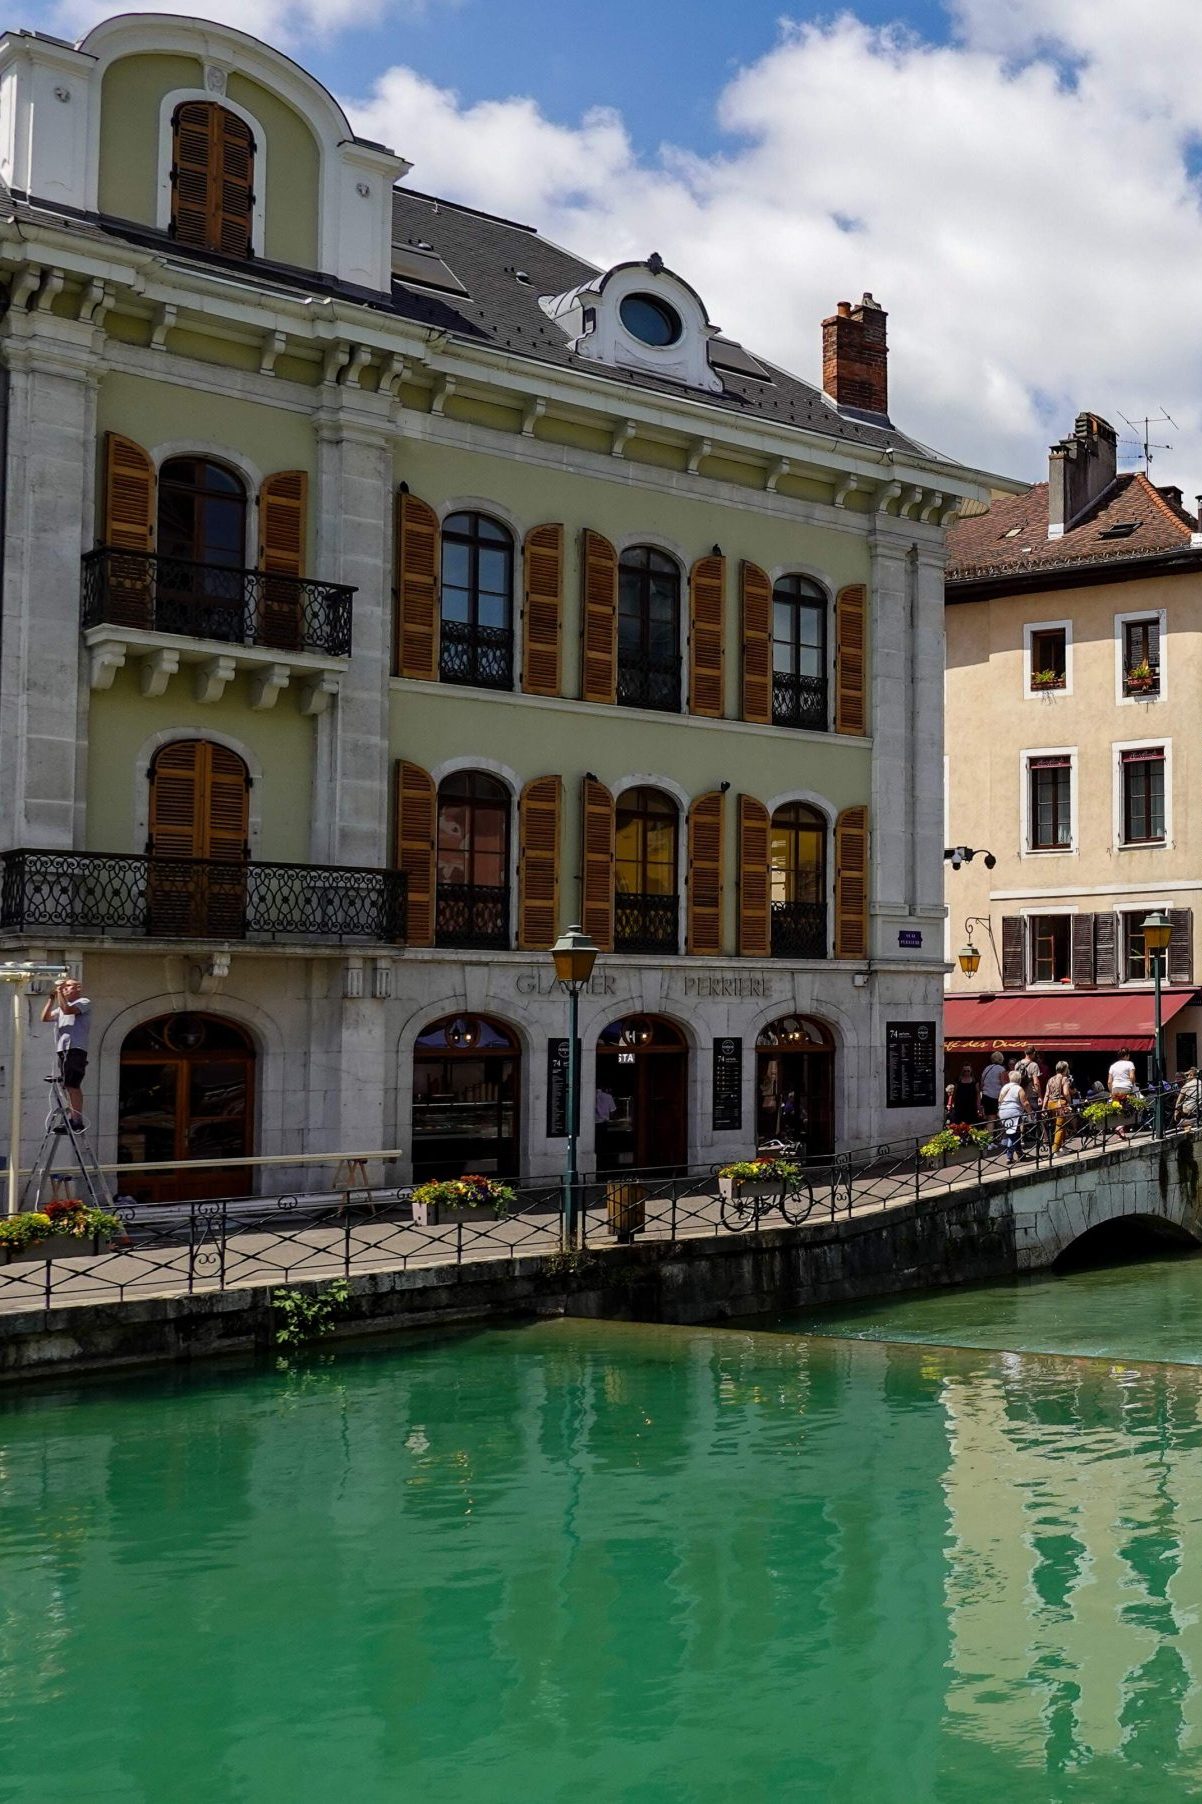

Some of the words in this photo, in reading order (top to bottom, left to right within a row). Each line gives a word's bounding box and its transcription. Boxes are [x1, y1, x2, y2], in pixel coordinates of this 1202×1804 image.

[516, 974, 616, 995] GLAIER
[961, 1040, 988, 1048] des
[991, 1039, 1028, 1049] Ducs
